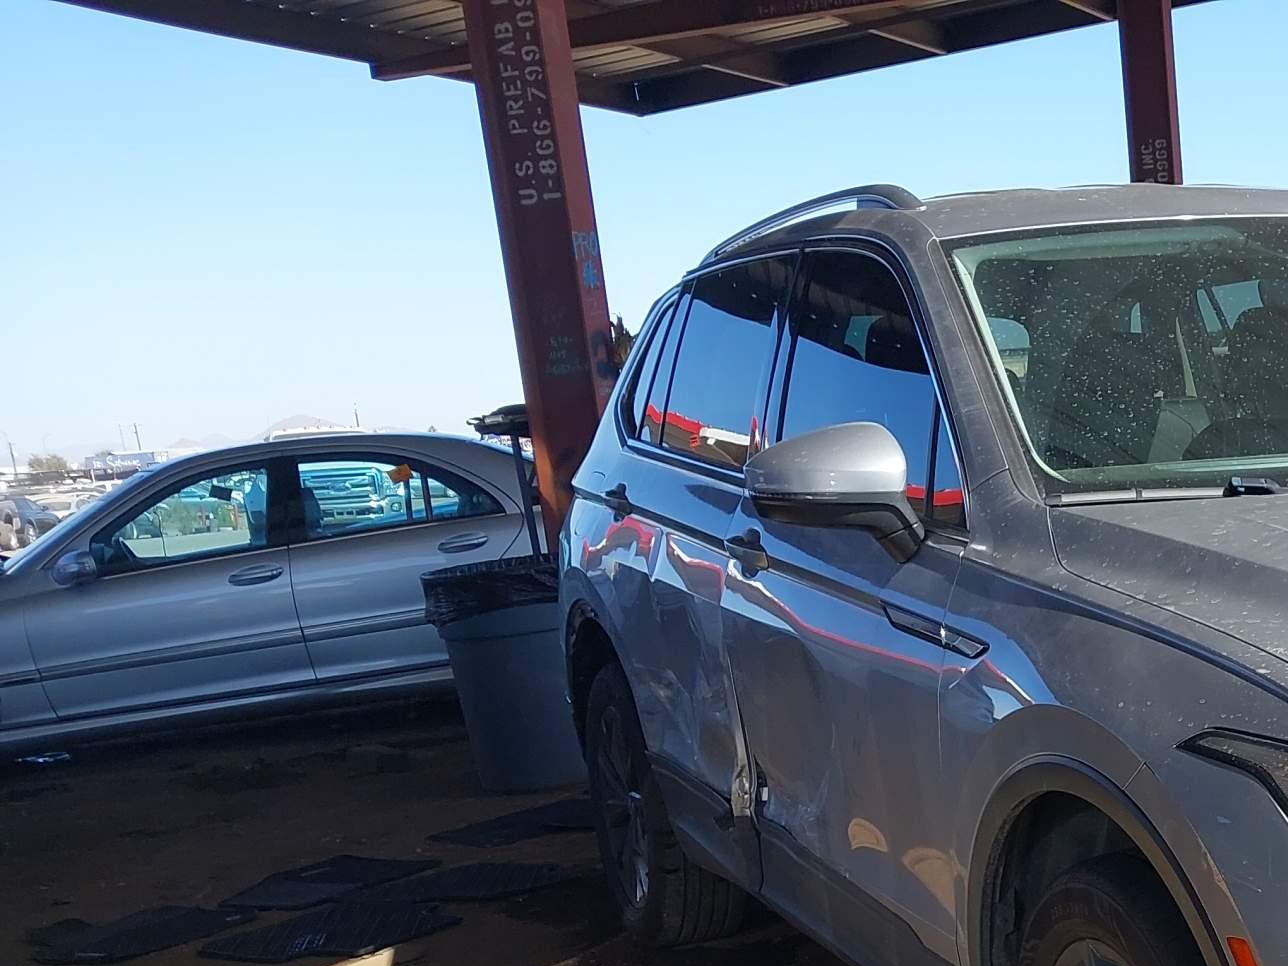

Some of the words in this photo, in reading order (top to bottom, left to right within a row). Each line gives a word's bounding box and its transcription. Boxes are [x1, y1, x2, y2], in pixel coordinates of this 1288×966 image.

[494, 21, 528, 135] PREFAB
[514, 151, 538, 206] U.S.
[1141, 138, 1155, 169] INC.
